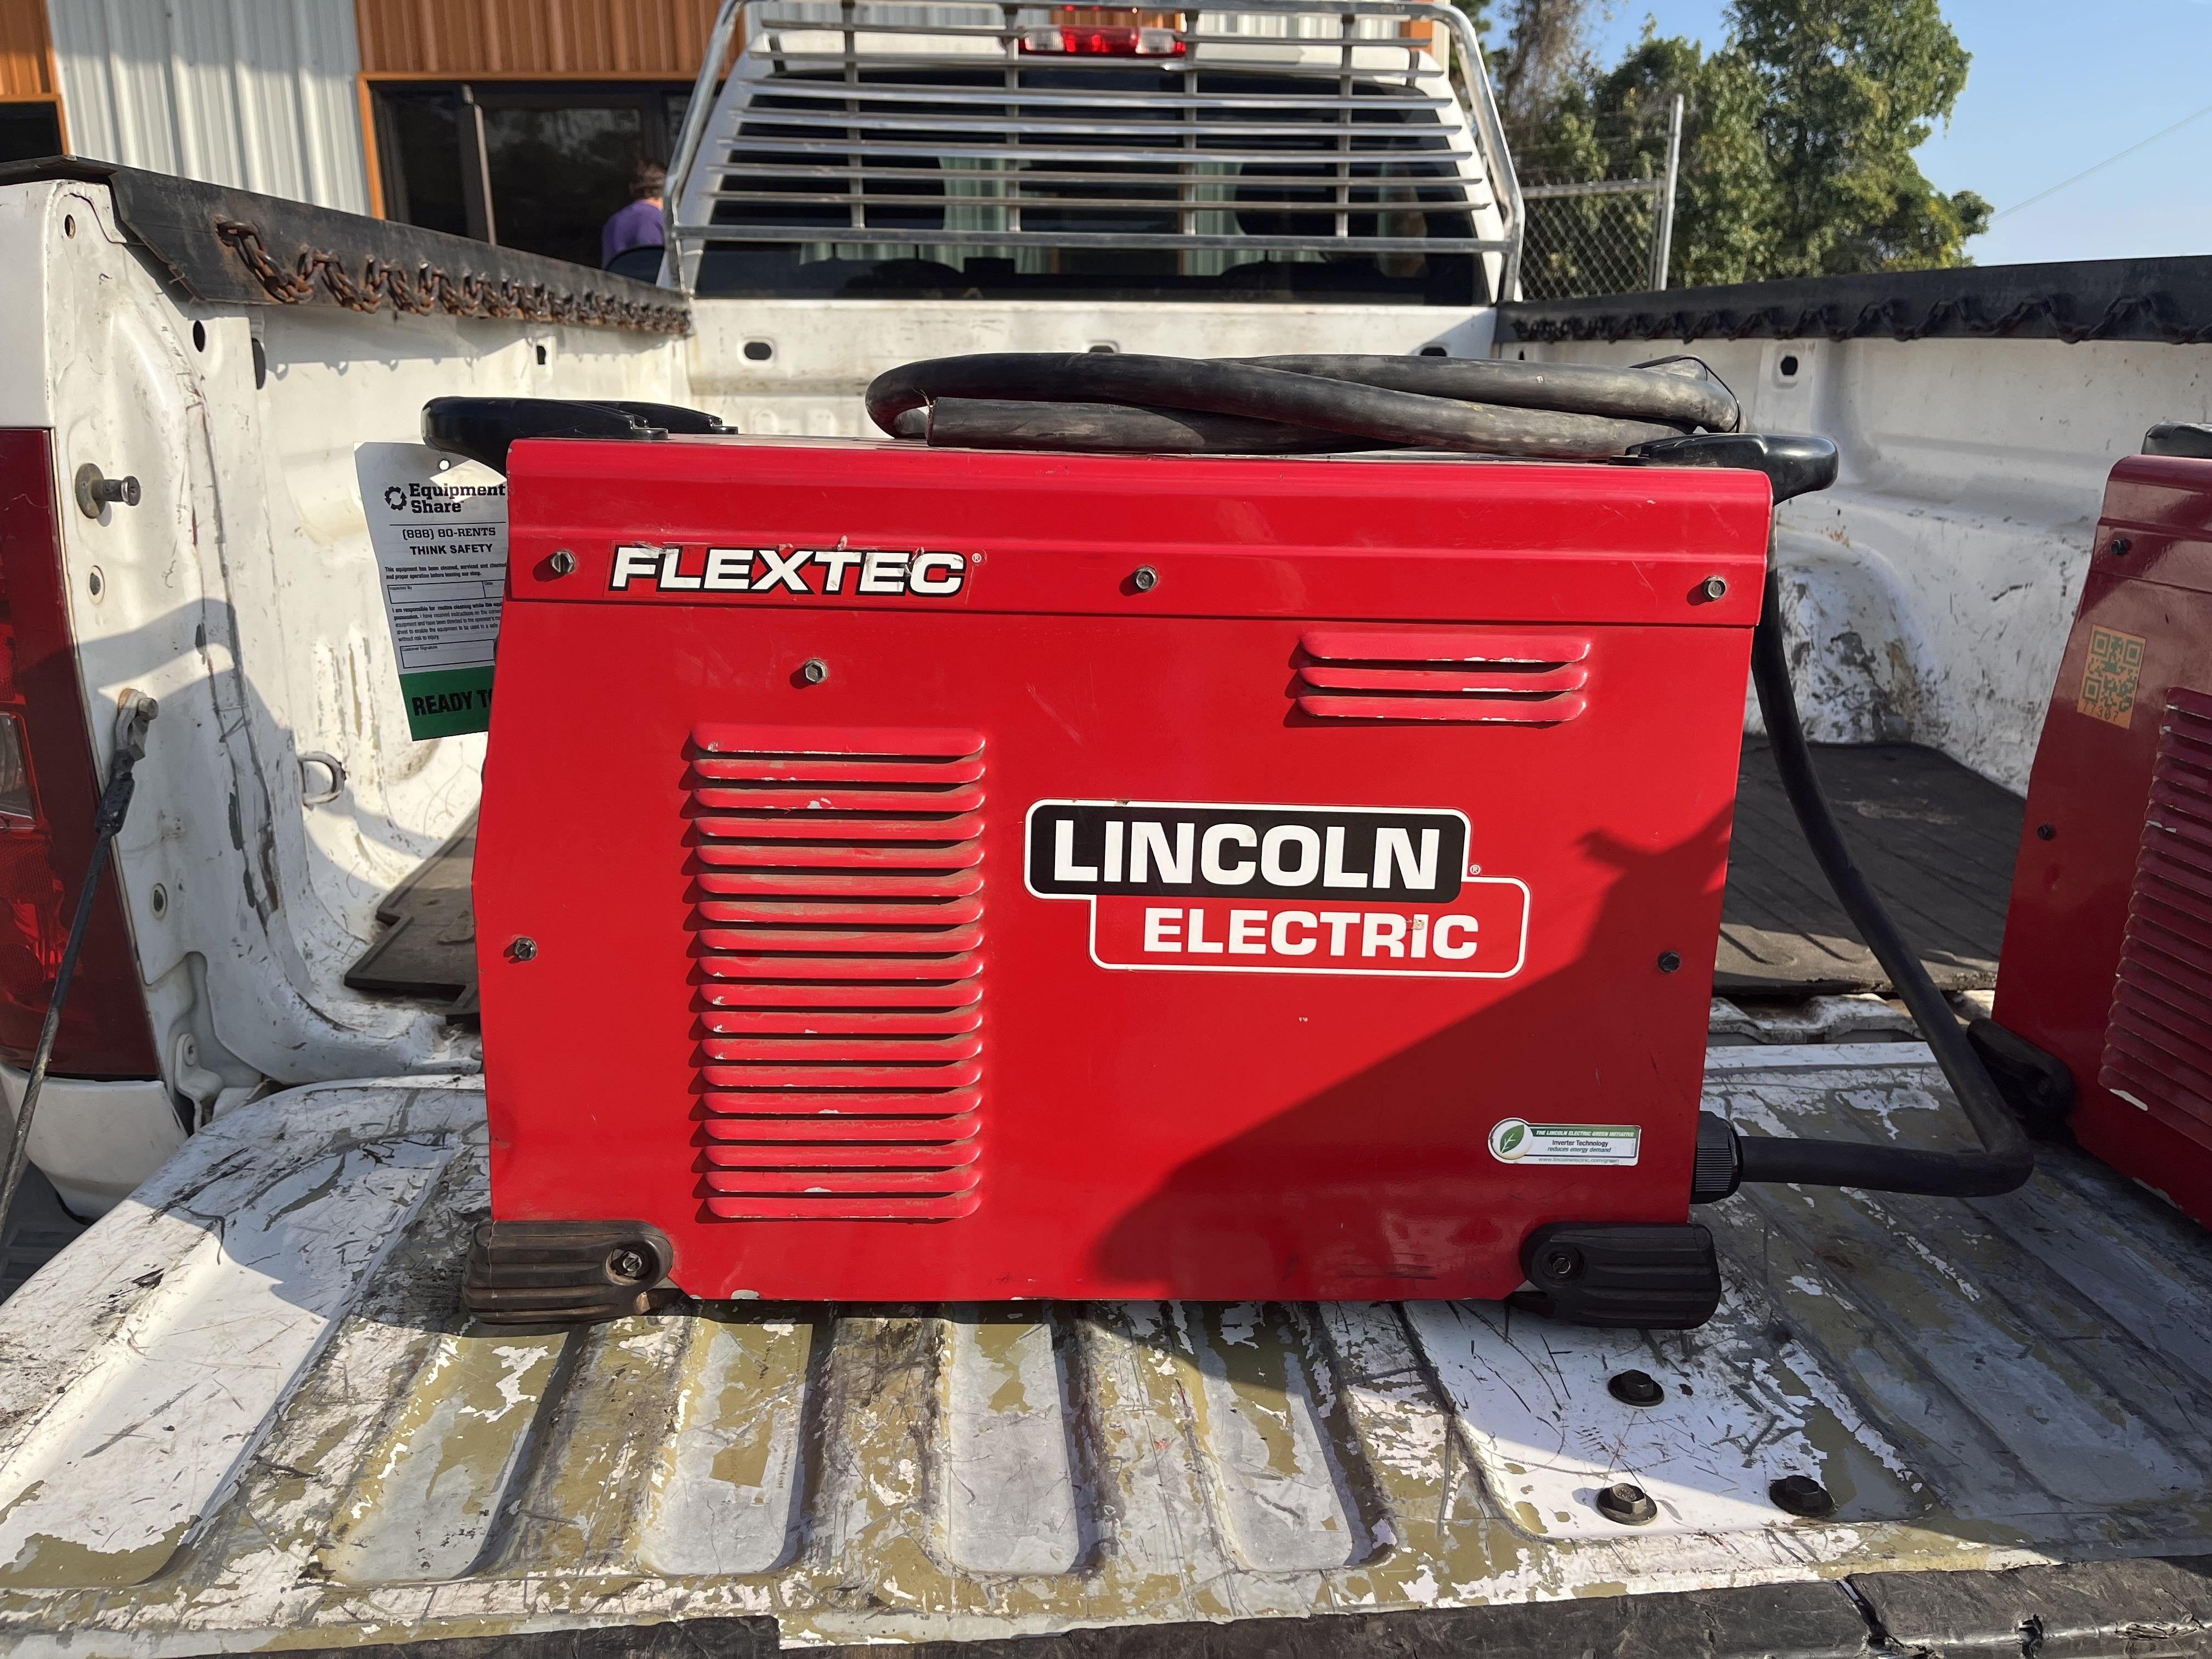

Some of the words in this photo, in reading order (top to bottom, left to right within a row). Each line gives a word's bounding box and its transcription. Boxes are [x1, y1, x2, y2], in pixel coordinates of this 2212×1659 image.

[409, 483, 506, 500] Equipment
[411, 500, 461, 514] Share
[403, 528, 435, 540] (888)
[438, 527, 496, 538] 80-RENTS
[410, 545, 447, 555] THINK
[450, 544, 493, 554] SAFETY
[610, 545, 964, 595] FLEXTEC
[412, 691, 472, 716] READY
[2084, 700, 2119, 721] 77307
[1053, 819, 1440, 890] LINCOLN
[1143, 906, 1479, 960] ELECTRIC
